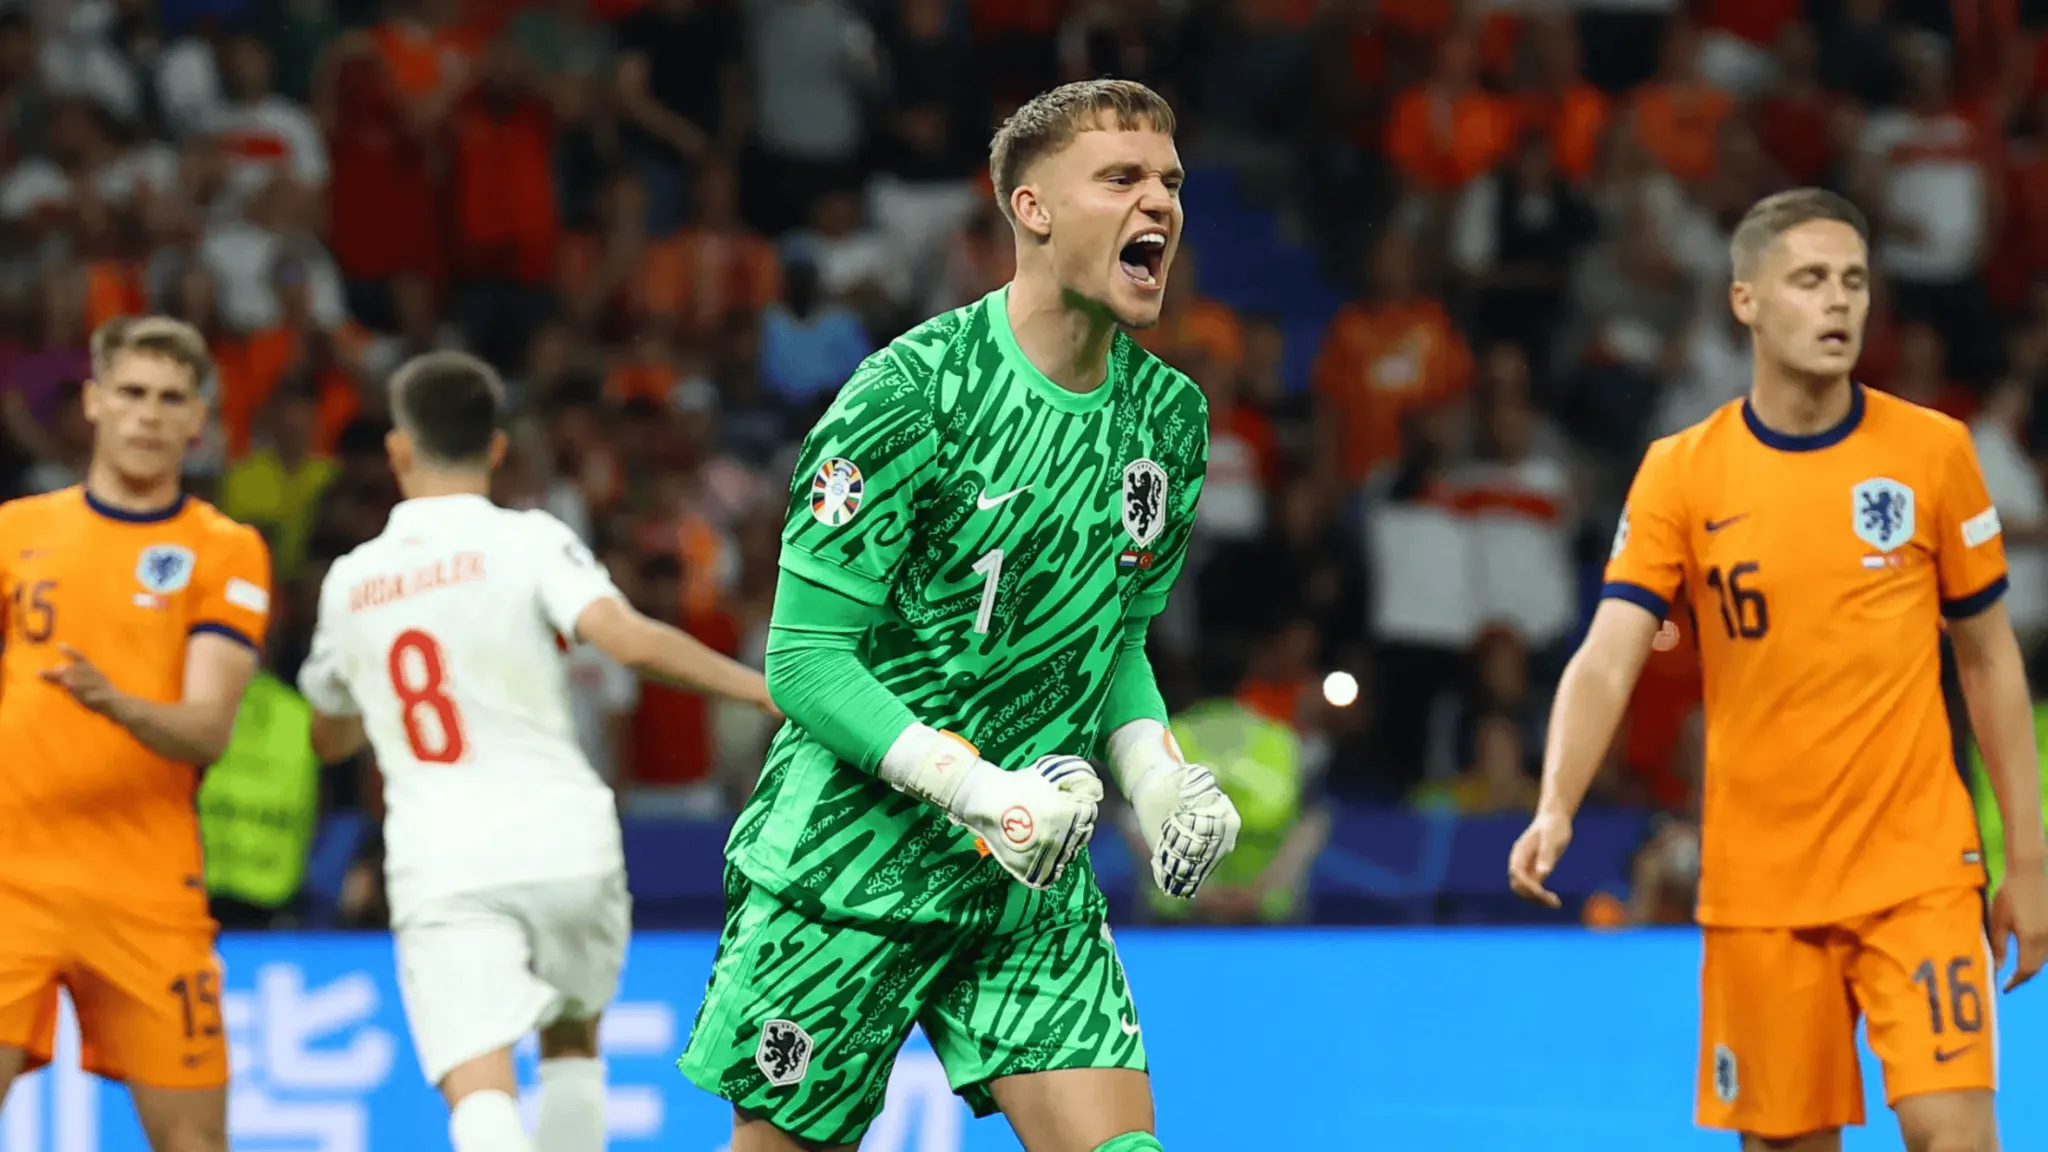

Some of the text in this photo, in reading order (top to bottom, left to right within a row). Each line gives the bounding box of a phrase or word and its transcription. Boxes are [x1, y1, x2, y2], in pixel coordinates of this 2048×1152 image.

[11, 579, 60, 645] 15
[971, 548, 1004, 635] 1
[1706, 560, 1768, 640] 16
[387, 627, 466, 766] 8
[167, 970, 221, 1040] 15
[1911, 956, 1982, 1034] 16
